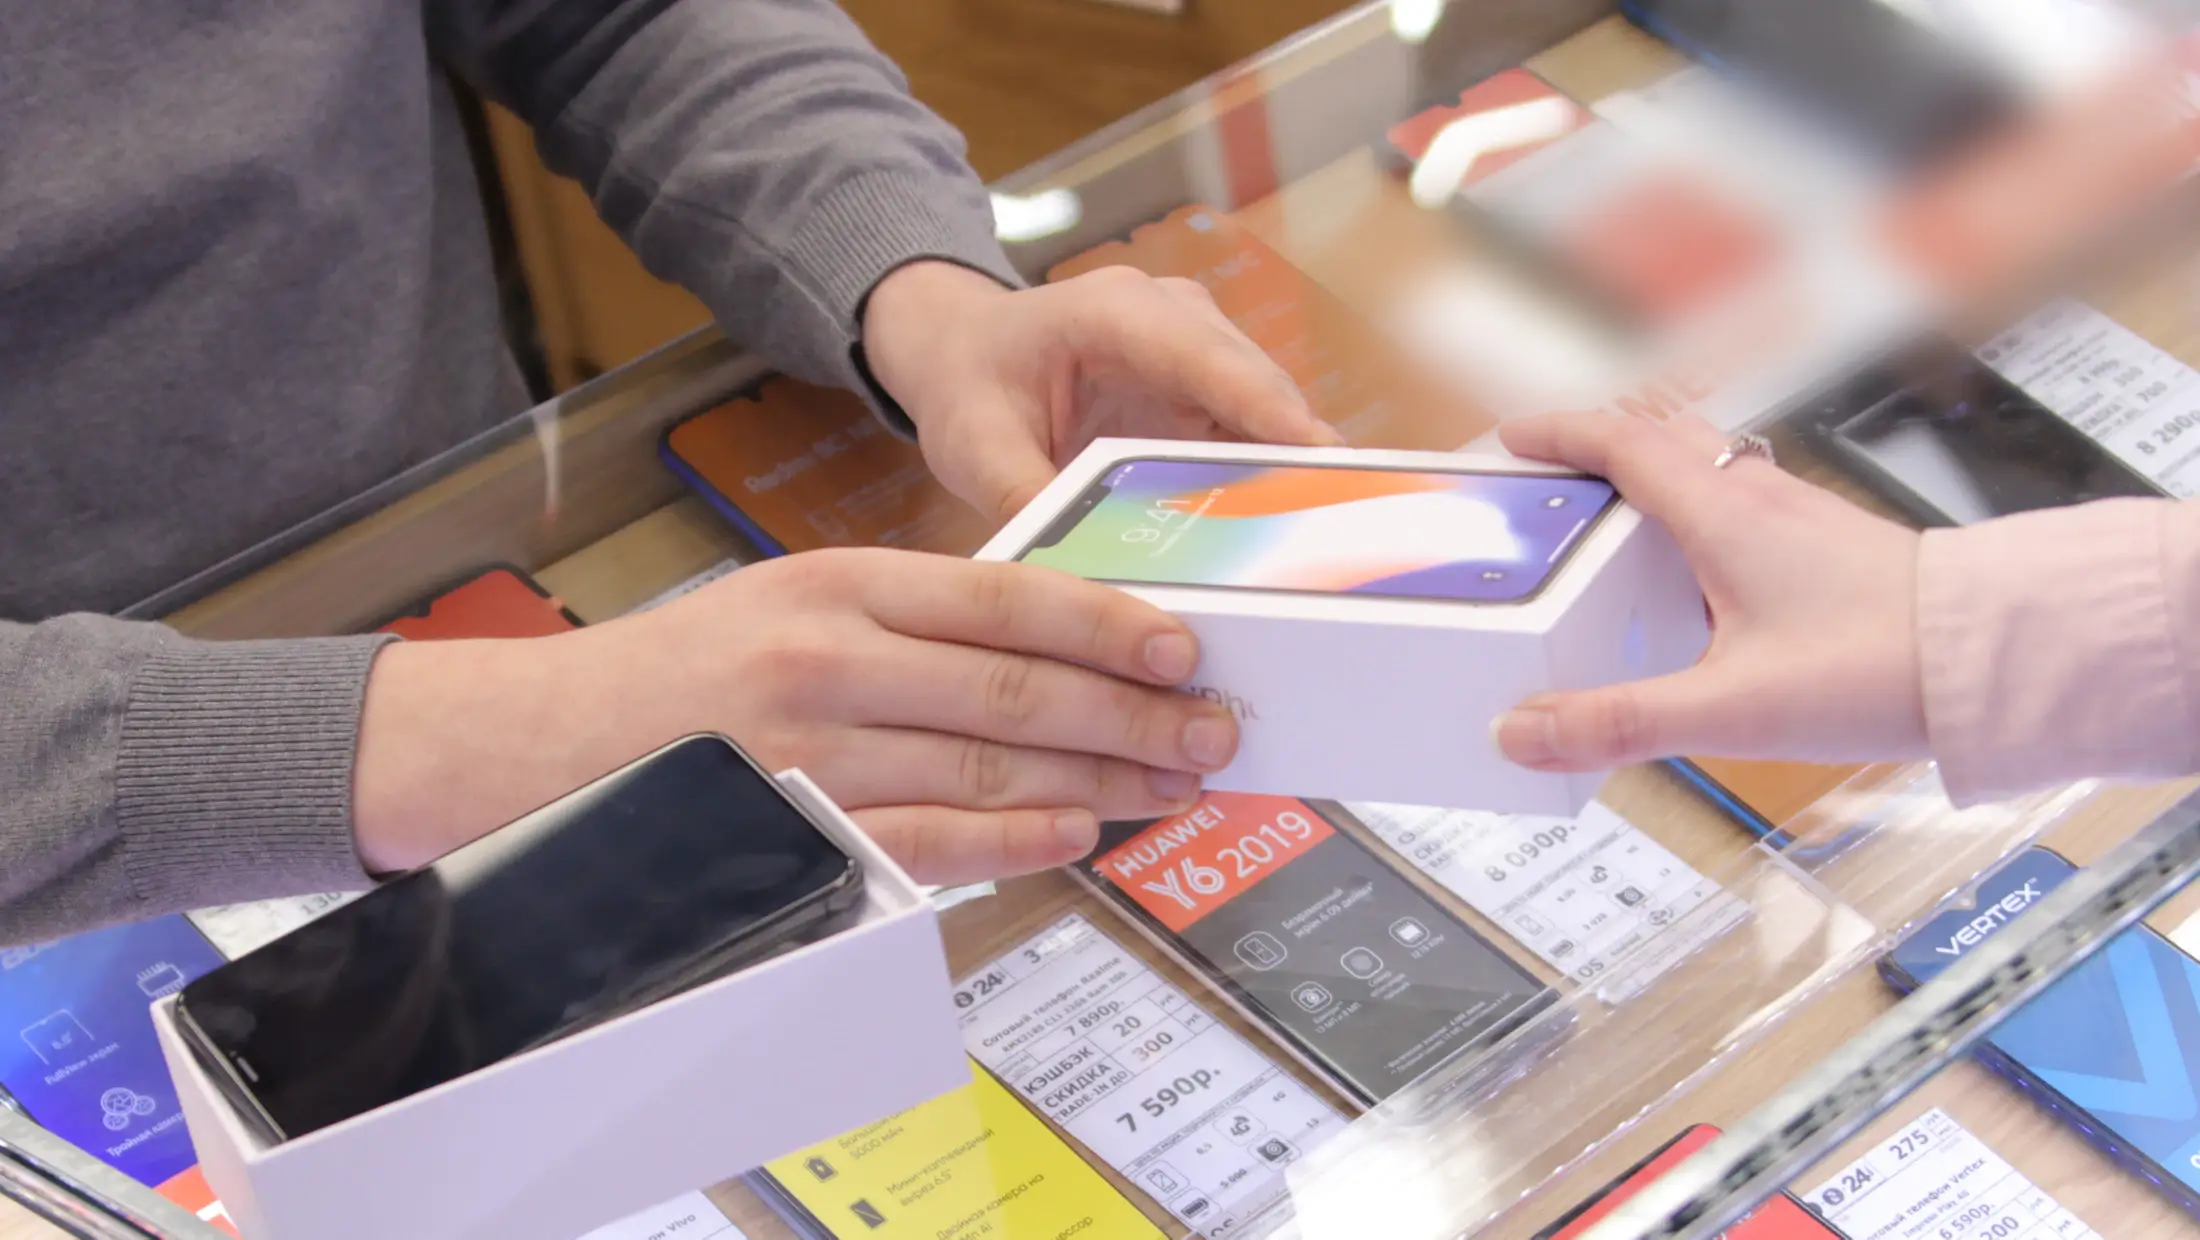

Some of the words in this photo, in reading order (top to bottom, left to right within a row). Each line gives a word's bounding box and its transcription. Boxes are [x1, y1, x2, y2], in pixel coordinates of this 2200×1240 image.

[1112, 804, 1226, 878] HUAWEI
[1141, 856, 1226, 910] Y6
[1216, 811, 1313, 879] 2019
[1484, 865, 1507, 882] 8
[1935, 882, 2041, 956] VERTEX
[1578, 957, 1604, 978] OS
[981, 1014, 1033, 1049] Сотовый
[1033, 985, 1081, 1019] телефон
[1080, 956, 1122, 986] Realme
[1063, 1024, 1076, 1037] 7
[1078, 998, 1126, 1030] 890р.
[1022, 1046, 1094, 1095] КЭШБЭК
[1112, 1015, 1142, 1039] 20
[1044, 1062, 1112, 1109] СКИДКА
[1131, 1031, 1174, 1063] 300
[1110, 1070, 1129, 1087] ДО
[1115, 1112, 1138, 1133] 7
[1140, 1067, 1221, 1118] 590р.
[106, 1128, 154, 1157] Тройная
[152, 1111, 185, 1134] камер
[849, 1138, 881, 1160] 5000
[1841, 1168, 1872, 1194] 24
[1889, 1129, 1929, 1161] 275
[900, 1182, 935, 1207] вырез
[935, 1208, 985, 1240] Двойная
[986, 1182, 1028, 1213] камера
[1028, 1172, 1045, 1188] на
[1867, 1212, 1906, 1240] отовый
[1906, 1182, 1951, 1216] телефон
[1950, 1157, 1987, 1184] Vertex
[1939, 1227, 1953, 1240] 6
[1951, 1202, 1996, 1233] 590р.
[666, 1213, 697, 1233] Vivo
[1979, 1215, 2020, 1240] 200
